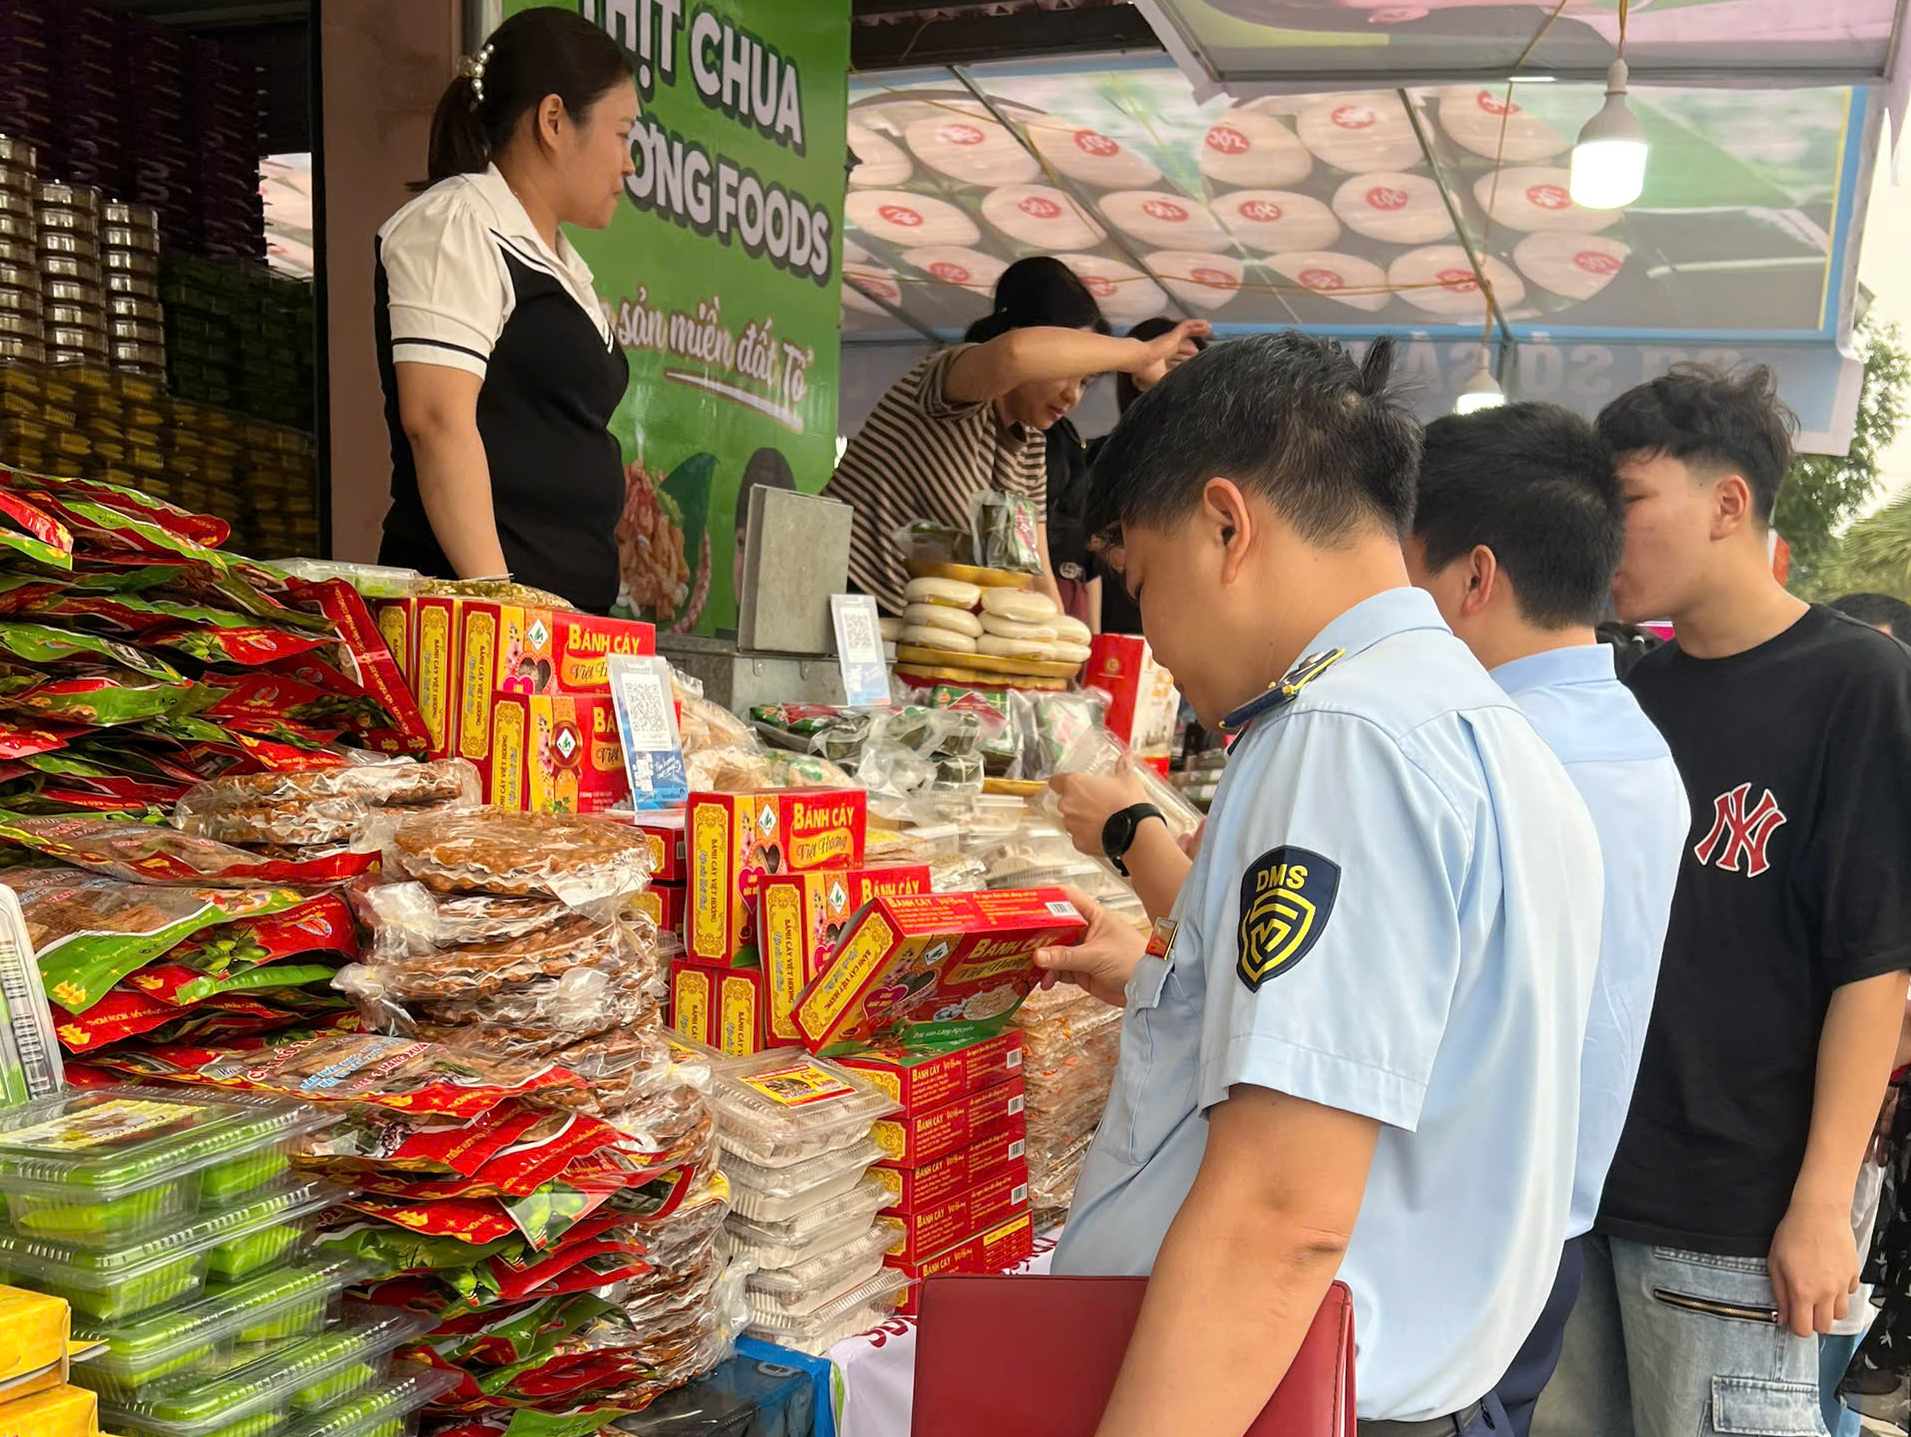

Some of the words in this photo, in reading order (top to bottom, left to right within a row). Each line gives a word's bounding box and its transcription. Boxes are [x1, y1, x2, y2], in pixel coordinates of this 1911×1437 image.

[691, 12, 803, 145] CHUA
[719, 163, 829, 276] FOODS
[617, 285, 668, 352] sản
[669, 295, 736, 371] miền
[737, 318, 782, 388] đất
[568, 623, 610, 651] BÁNH
[614, 632, 640, 655] CÁY
[593, 707, 617, 732] BÁ
[793, 802, 829, 830] BÁNH
[832, 803, 855, 828] CÁY
[1693, 782, 1787, 878] NY
[797, 843, 818, 860] Việt
[861, 877, 896, 904] BÁNH
[1255, 864, 1308, 893] DMS
